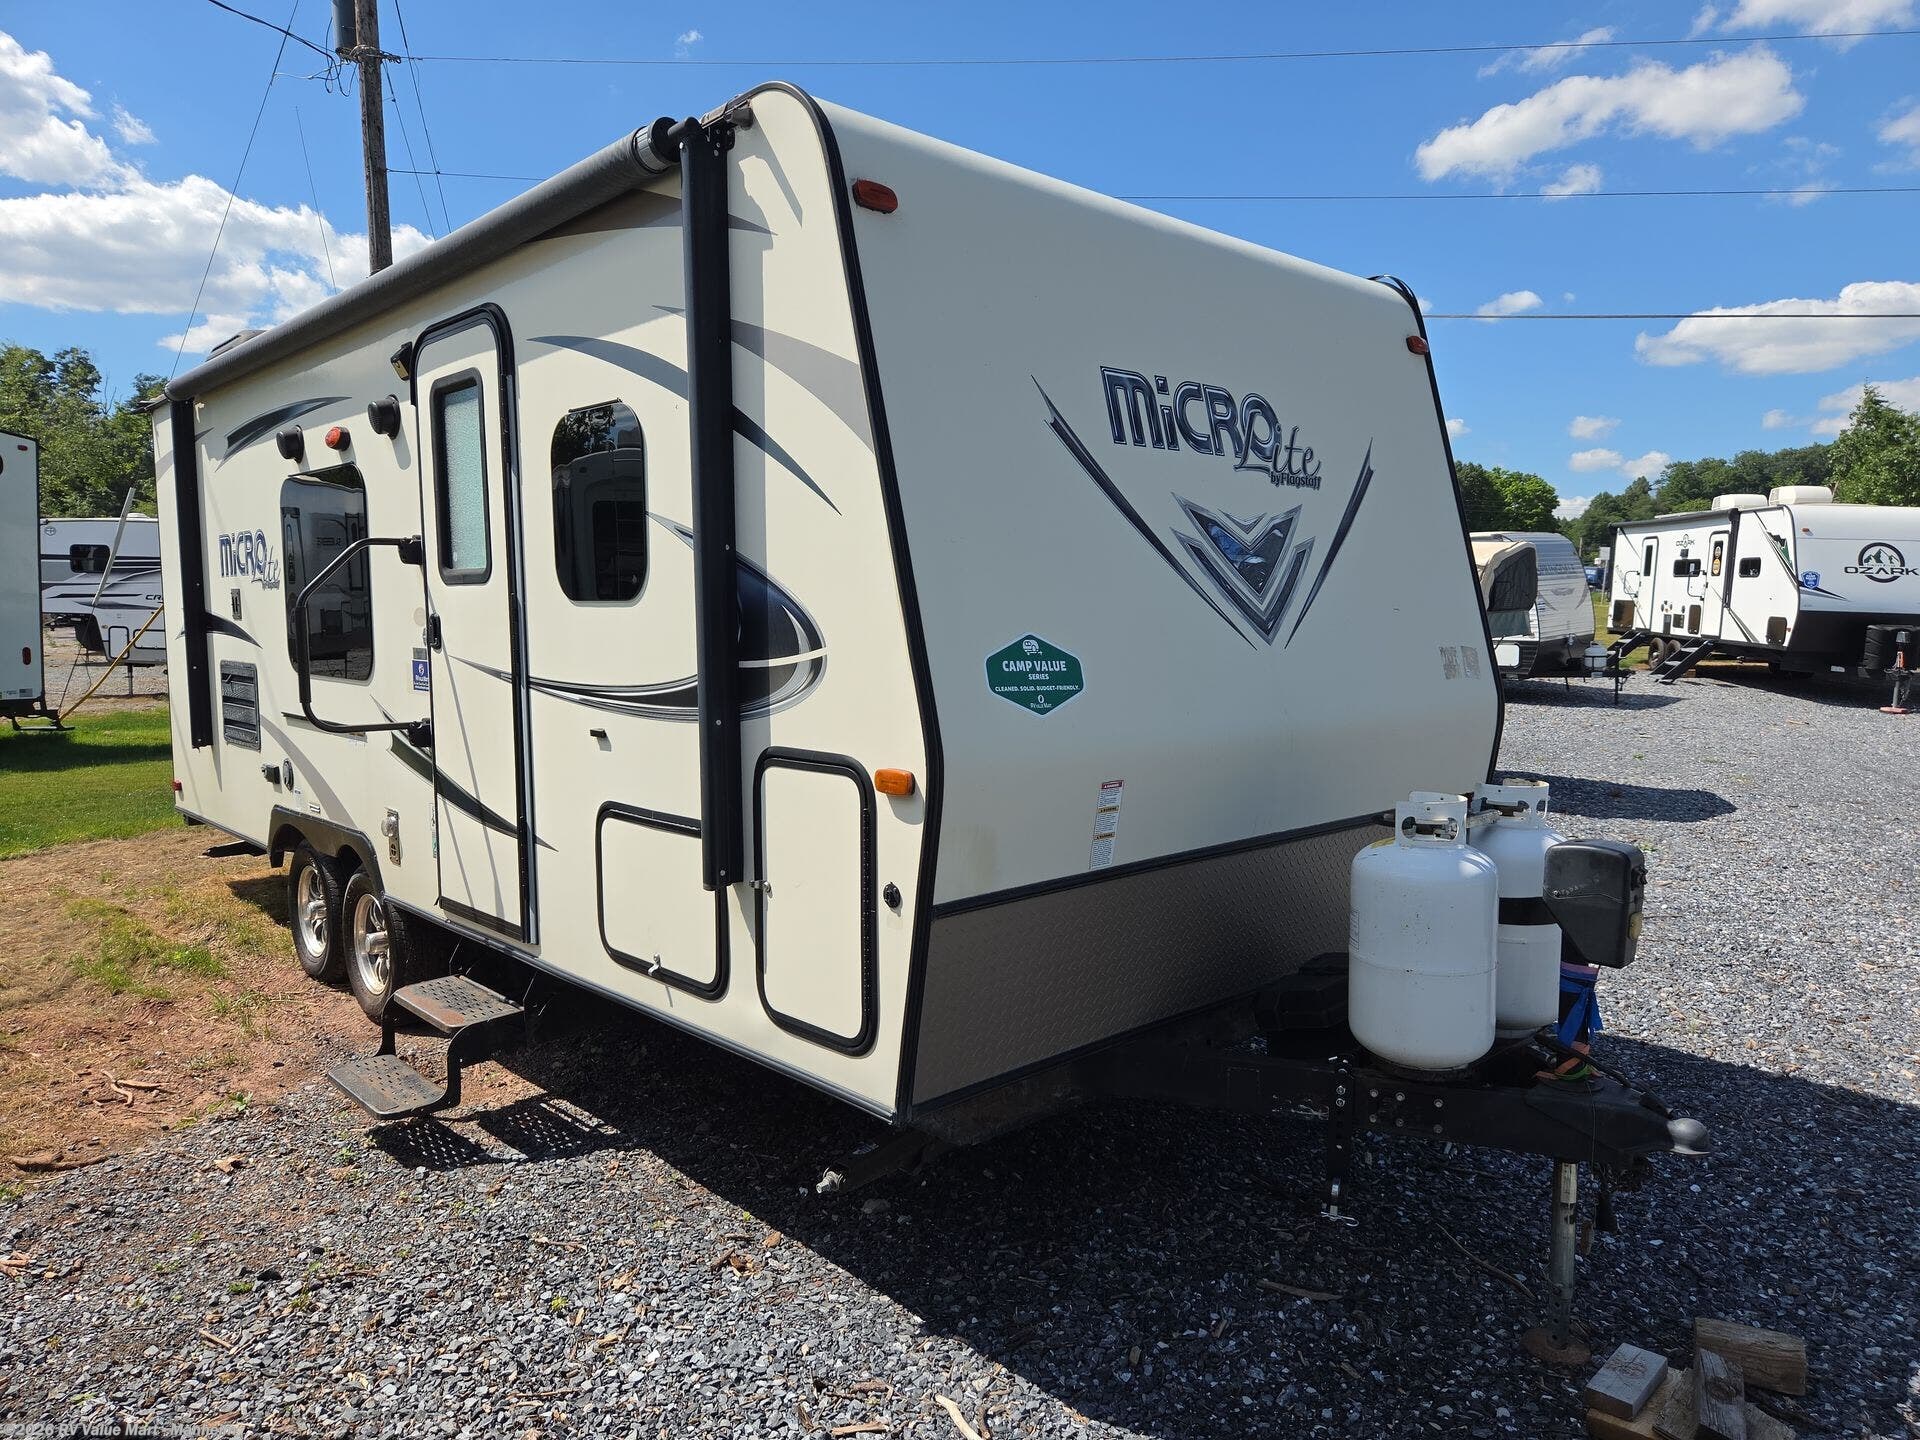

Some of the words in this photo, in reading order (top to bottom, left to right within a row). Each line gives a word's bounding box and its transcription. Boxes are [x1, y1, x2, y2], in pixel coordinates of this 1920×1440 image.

[1844, 566, 1919, 576] OZARK
[1002, 660, 1032, 672] CAMP
[1033, 660, 1067, 672] VALUE
[1028, 673, 1050, 681] SERIES
